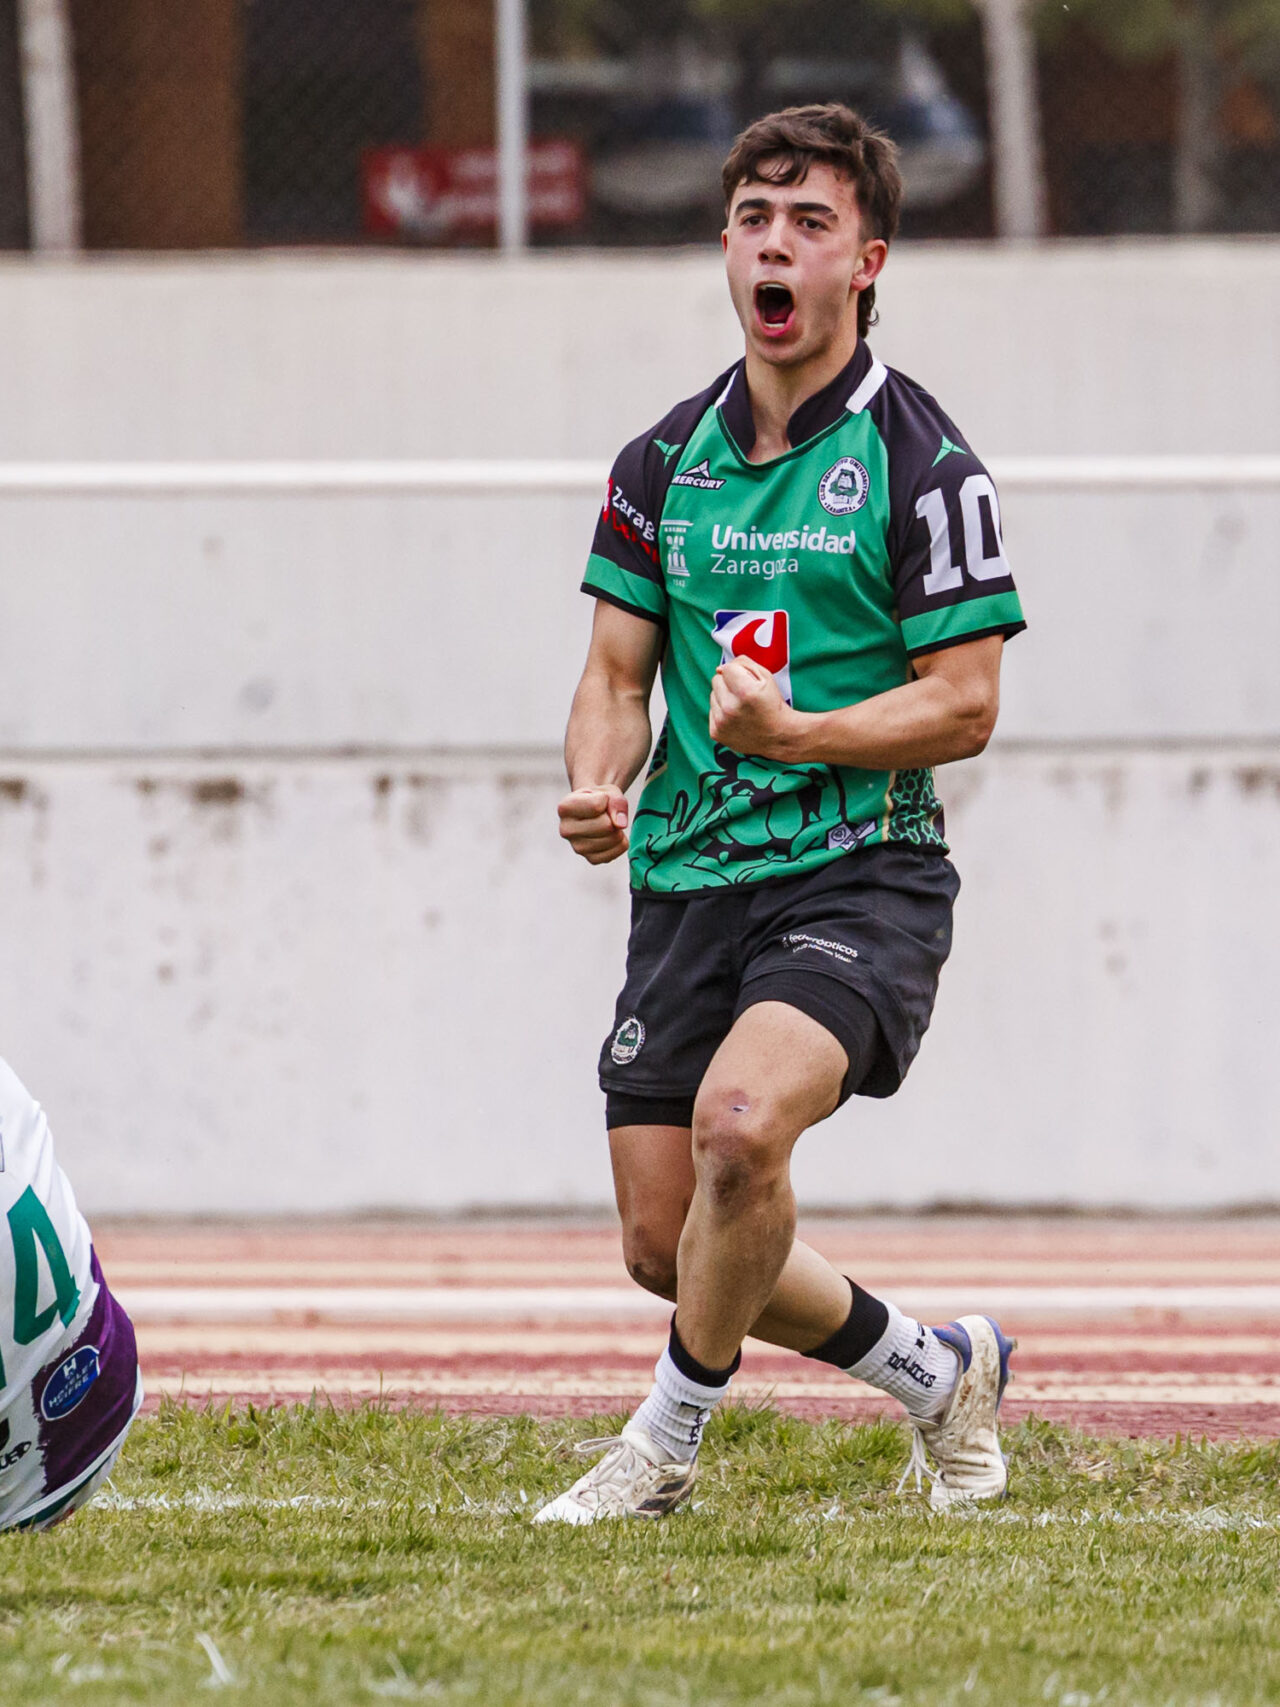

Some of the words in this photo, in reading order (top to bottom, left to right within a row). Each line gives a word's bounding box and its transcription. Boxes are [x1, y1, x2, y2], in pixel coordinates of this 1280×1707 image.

[711, 524, 856, 555] Universidad
[916, 474, 1011, 596] 10
[710, 553, 799, 581] Zaragoza
